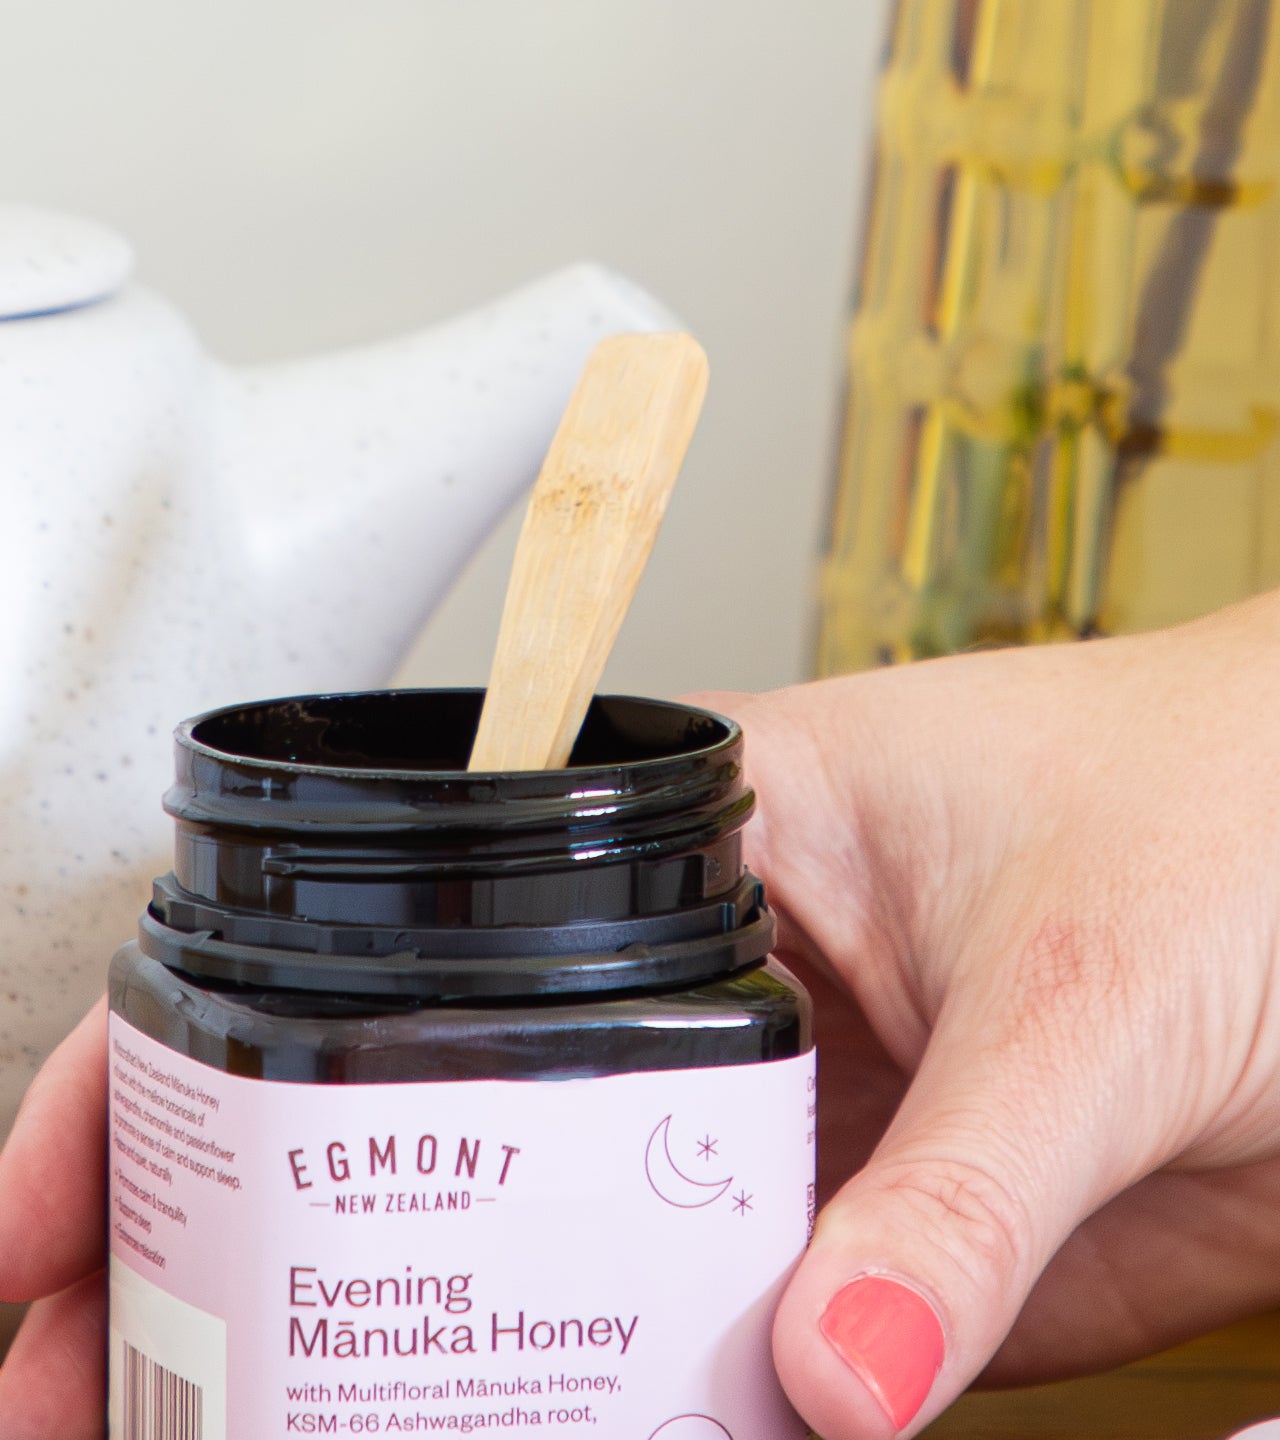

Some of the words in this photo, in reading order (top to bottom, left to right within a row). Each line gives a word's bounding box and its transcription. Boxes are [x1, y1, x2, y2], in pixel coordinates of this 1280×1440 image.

[287, 1133, 521, 1192] EGMONT
[335, 1193, 377, 1215] NEW
[385, 1190, 471, 1214] ZEALAND
[288, 1265, 473, 1315] Evening
[288, 1315, 478, 1359] Mānuka
[490, 1310, 639, 1355] Honey
[286, 1383, 332, 1403] with
[337, 1379, 450, 1403] Multifloral
[456, 1376, 543, 1399] Mānuka
[547, 1373, 622, 1397] Honey,
[286, 1412, 380, 1435] KSM-66
[385, 1406, 543, 1434] Ashwagandha
[547, 1404, 598, 1425] root,
